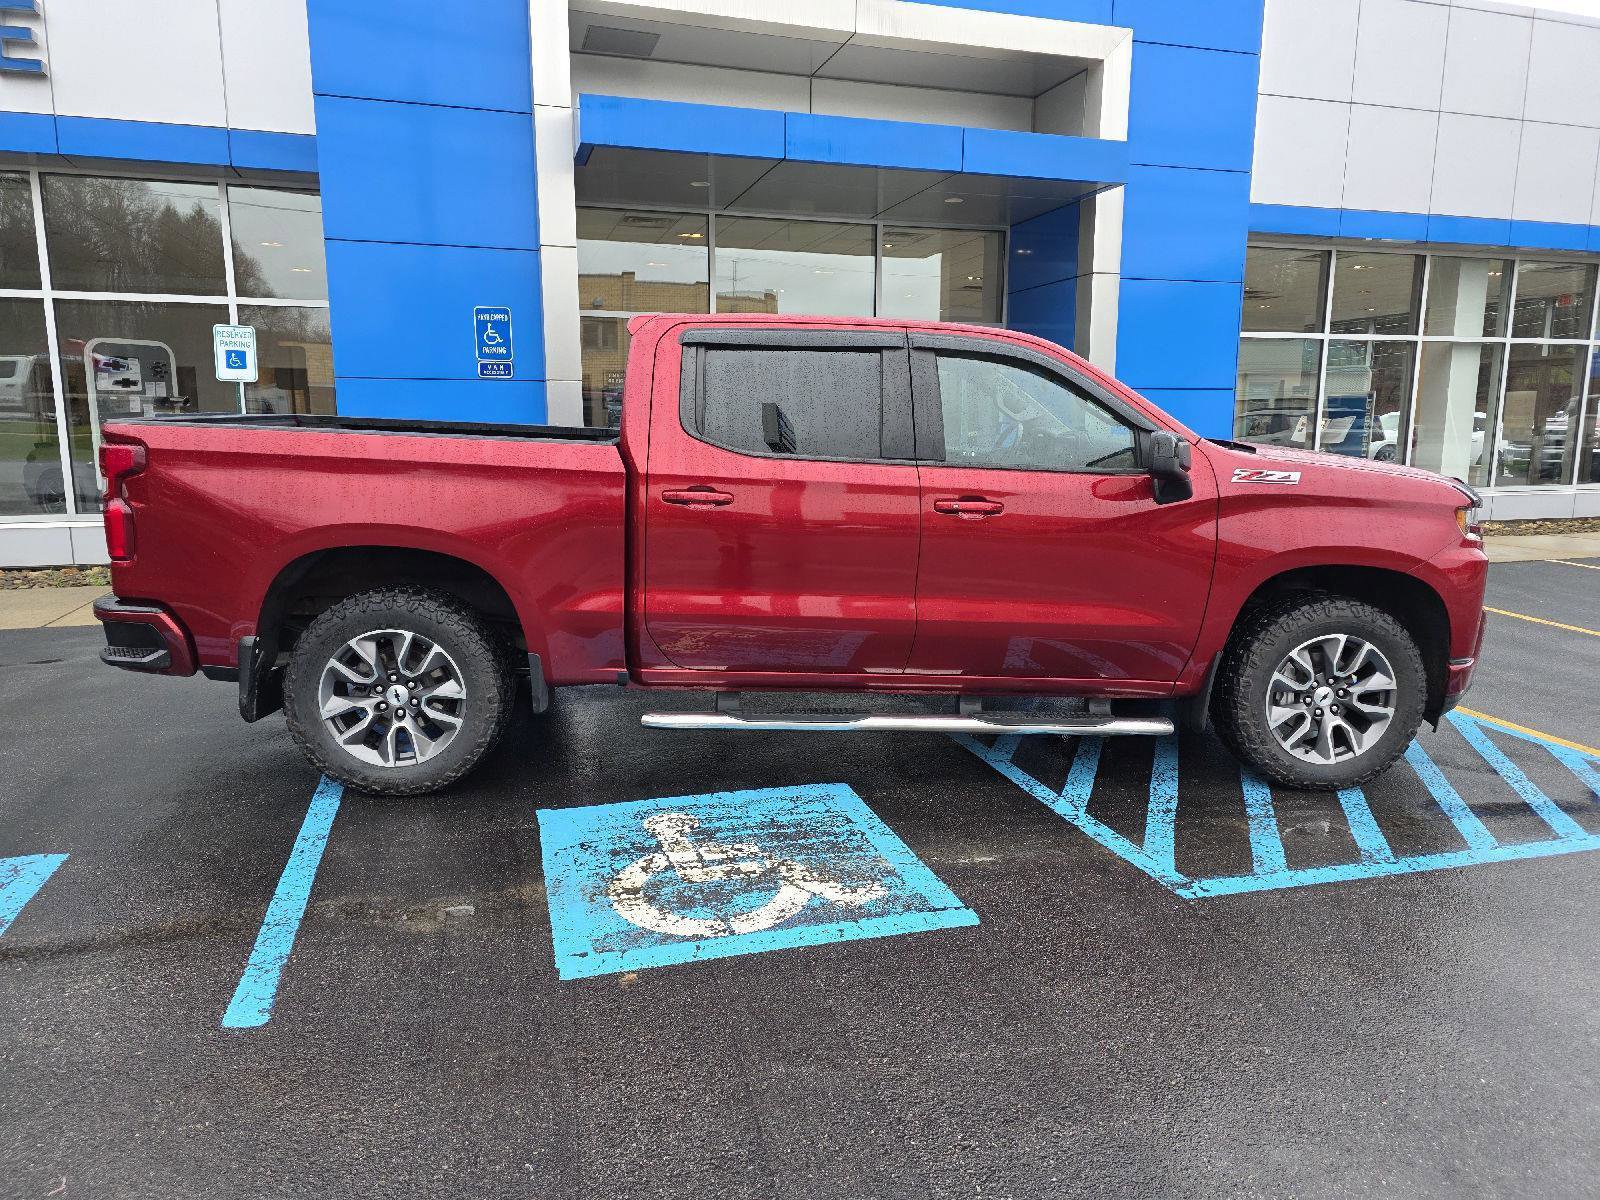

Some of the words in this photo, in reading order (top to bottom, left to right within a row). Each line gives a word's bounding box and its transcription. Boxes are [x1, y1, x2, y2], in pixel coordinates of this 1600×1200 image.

[216, 330, 252, 339] RESERVED
[219, 339, 251, 349] PARKING
[482, 346, 507, 355] PARKING
